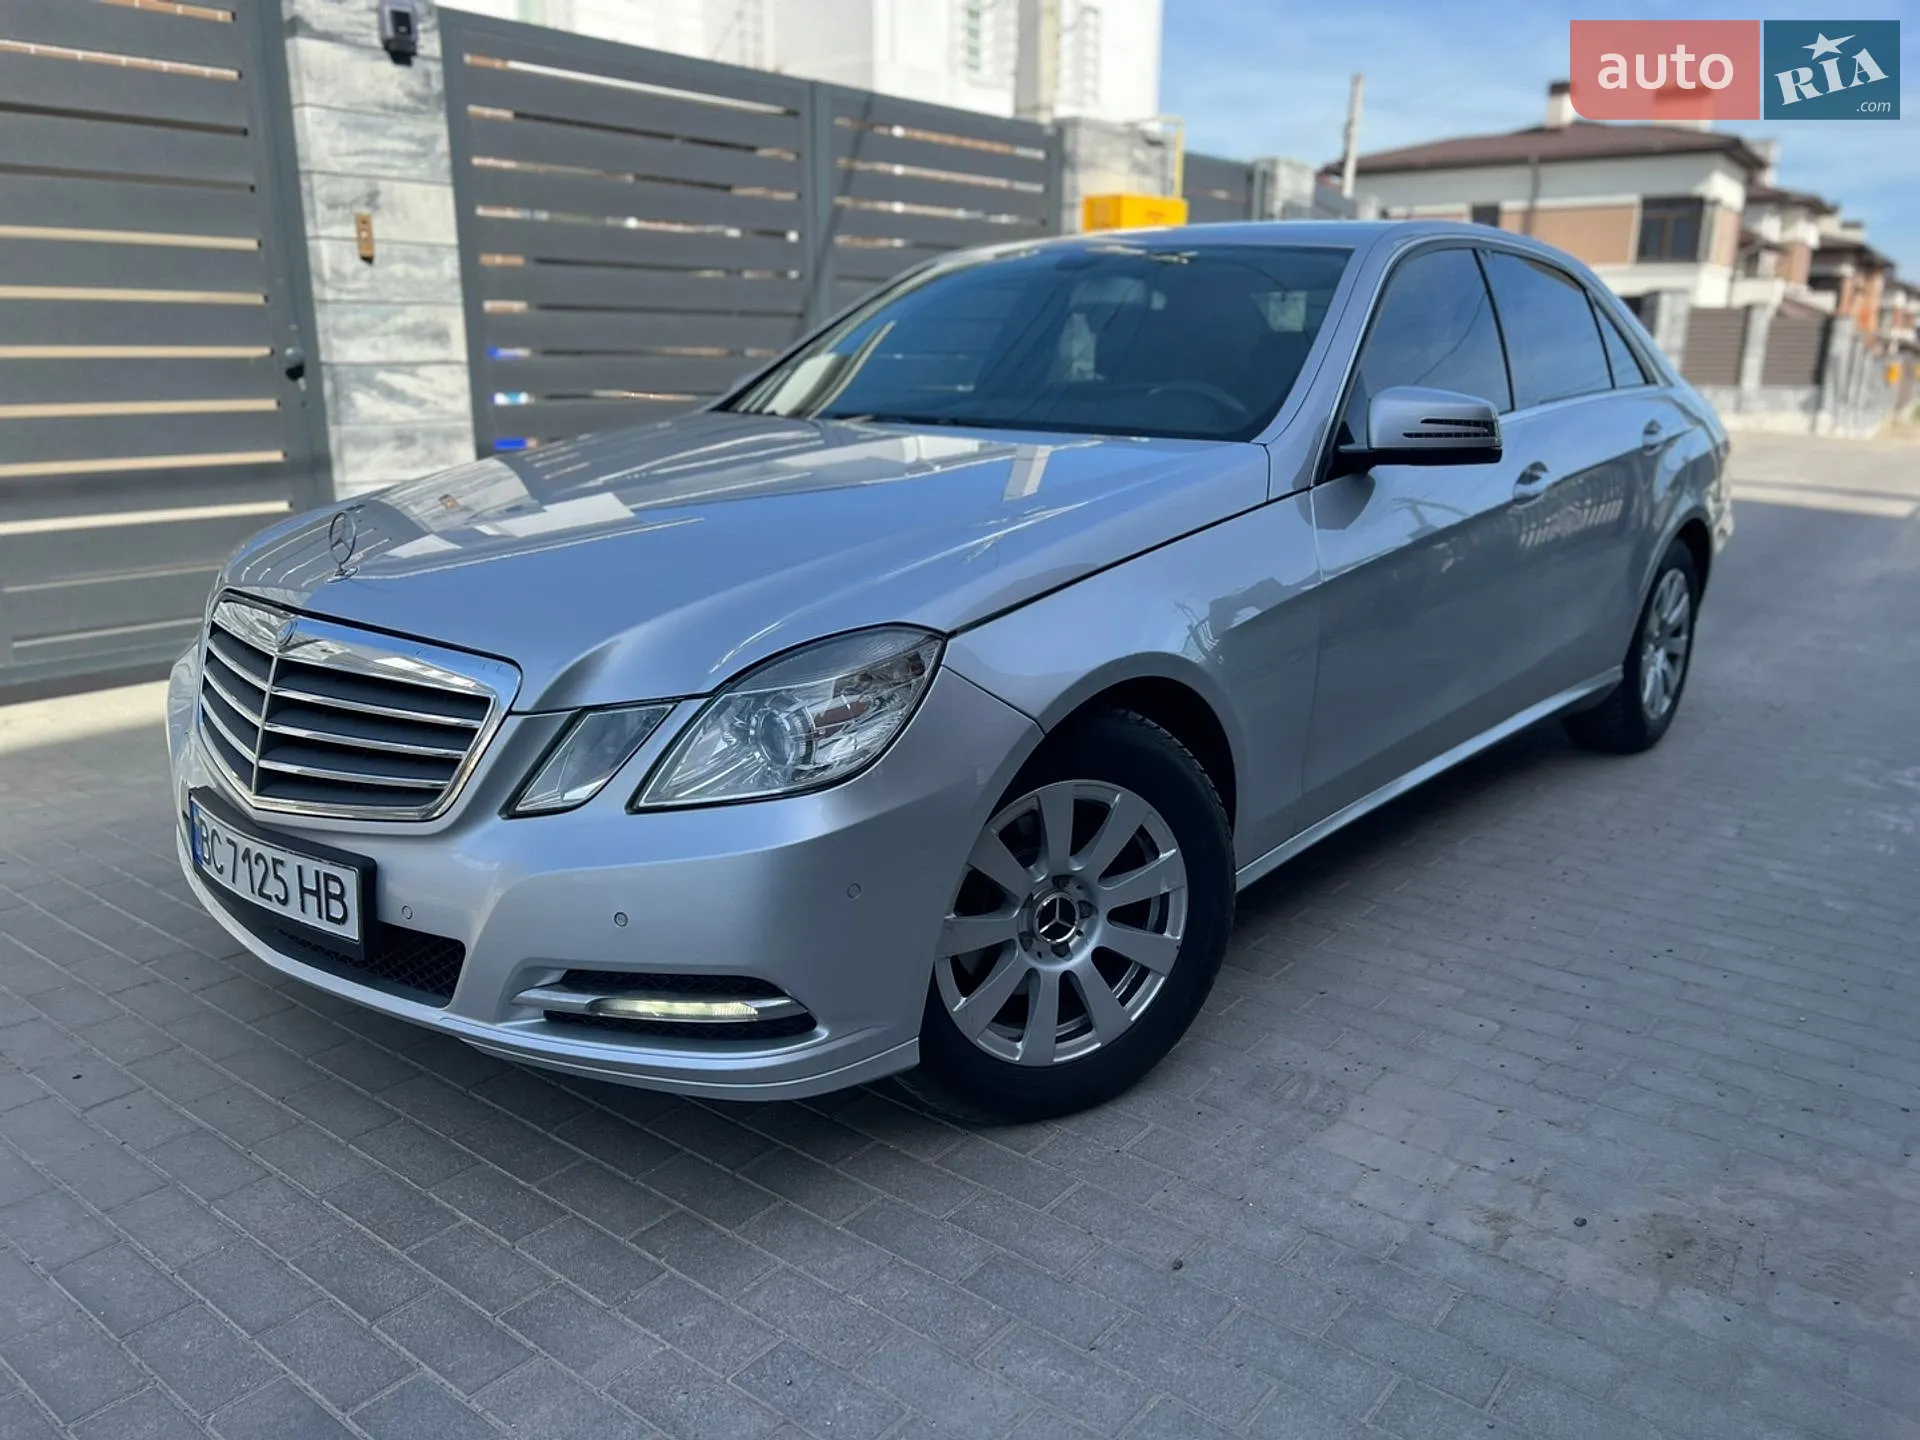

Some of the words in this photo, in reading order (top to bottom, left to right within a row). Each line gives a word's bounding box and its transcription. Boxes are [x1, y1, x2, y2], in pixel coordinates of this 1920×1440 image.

[202, 820, 224, 875] BC
[227, 838, 289, 906] 7125
[297, 864, 348, 925] HB
